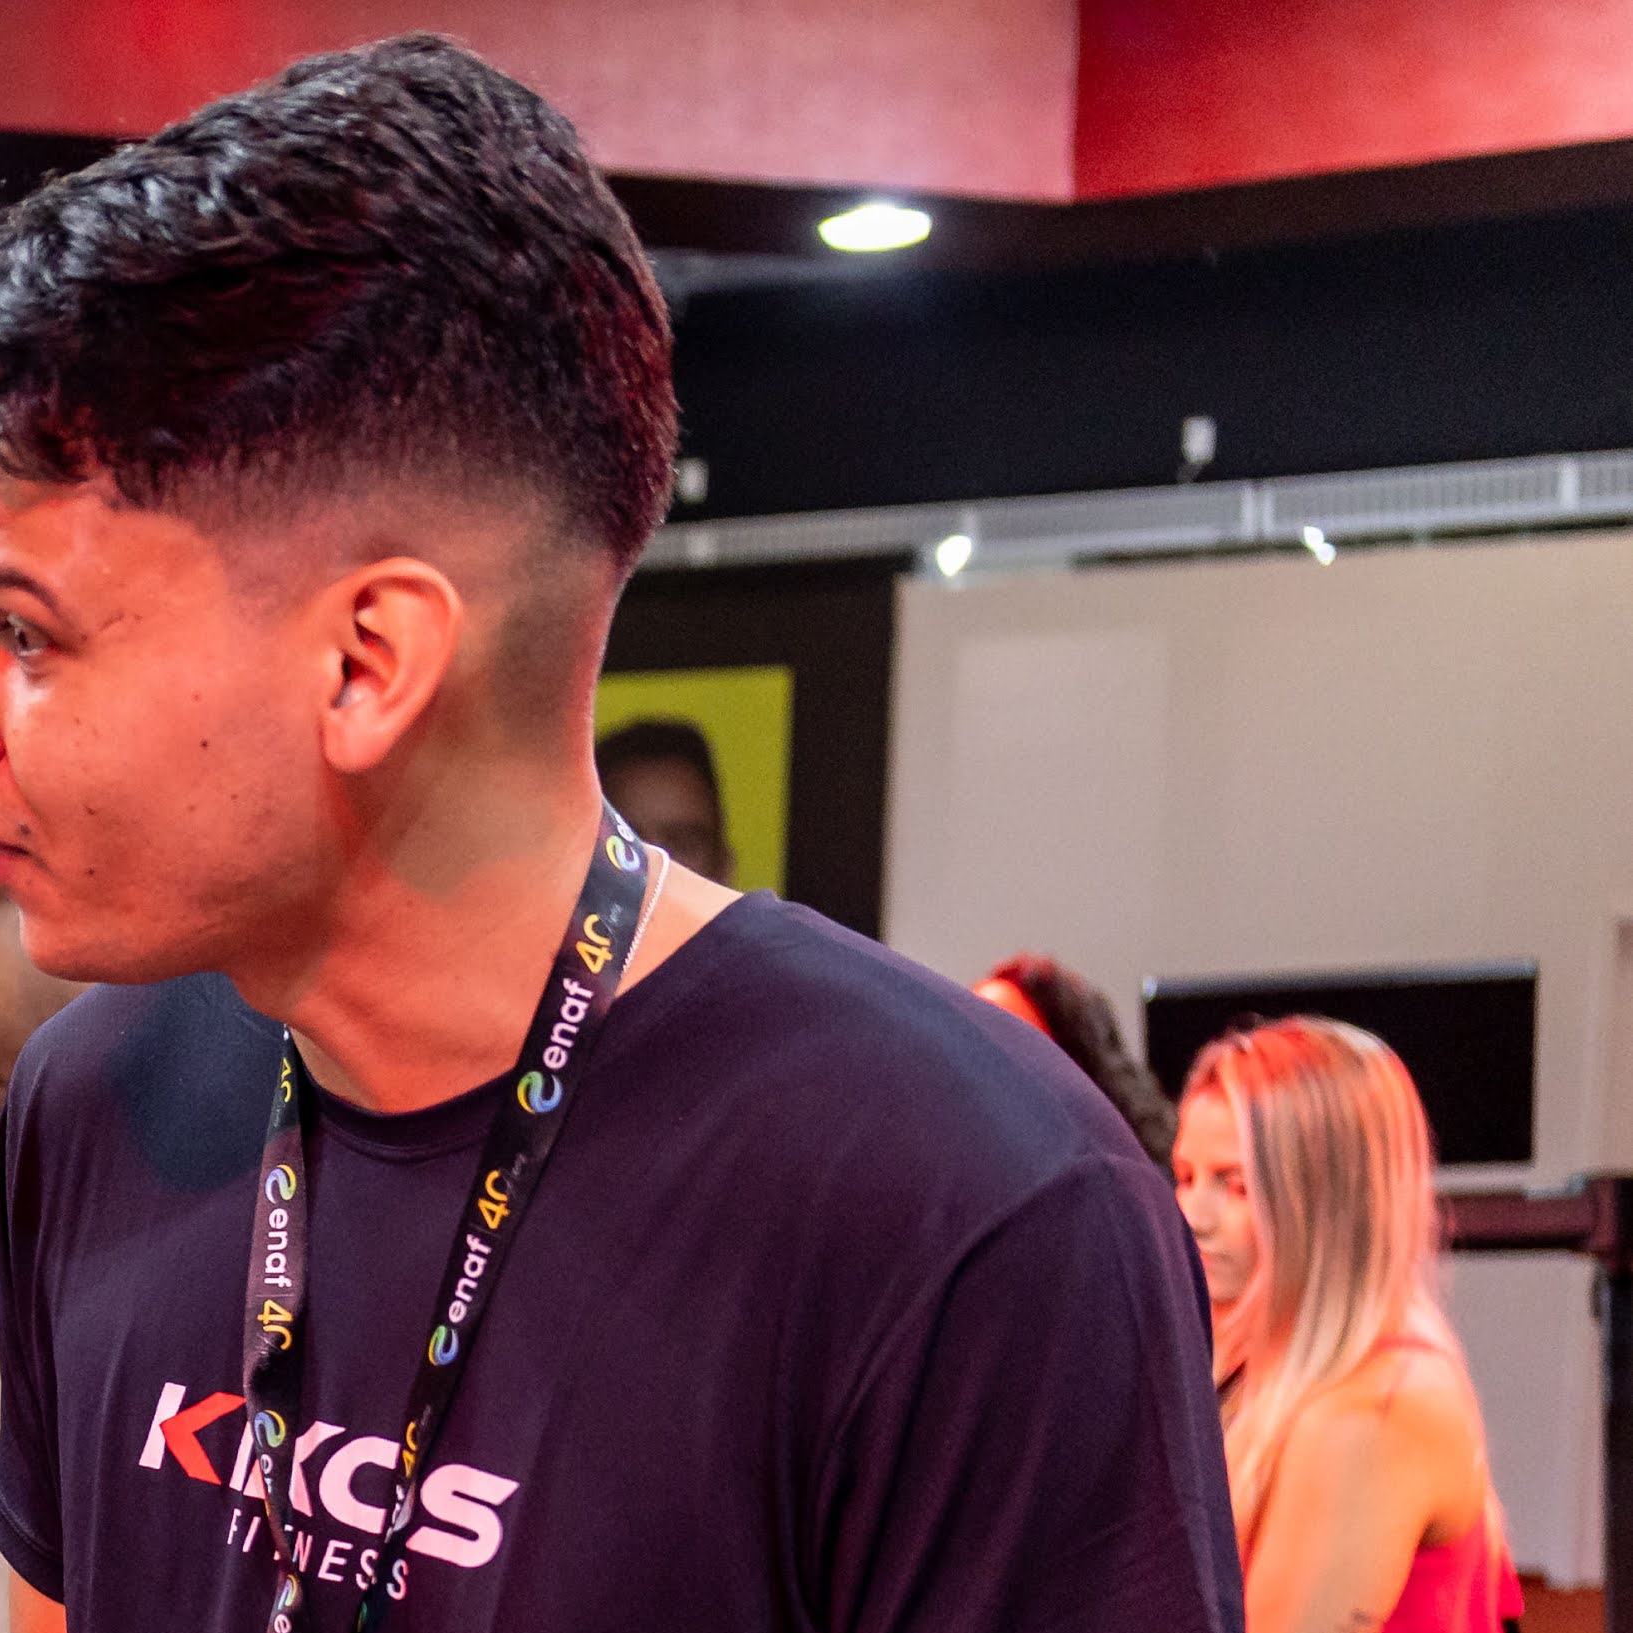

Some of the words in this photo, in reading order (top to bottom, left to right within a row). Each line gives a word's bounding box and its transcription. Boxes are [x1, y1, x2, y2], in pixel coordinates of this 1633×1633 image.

[542, 977, 594, 1070] enaf
[263, 1207, 294, 1289] enaf
[448, 1233, 492, 1324] enaf
